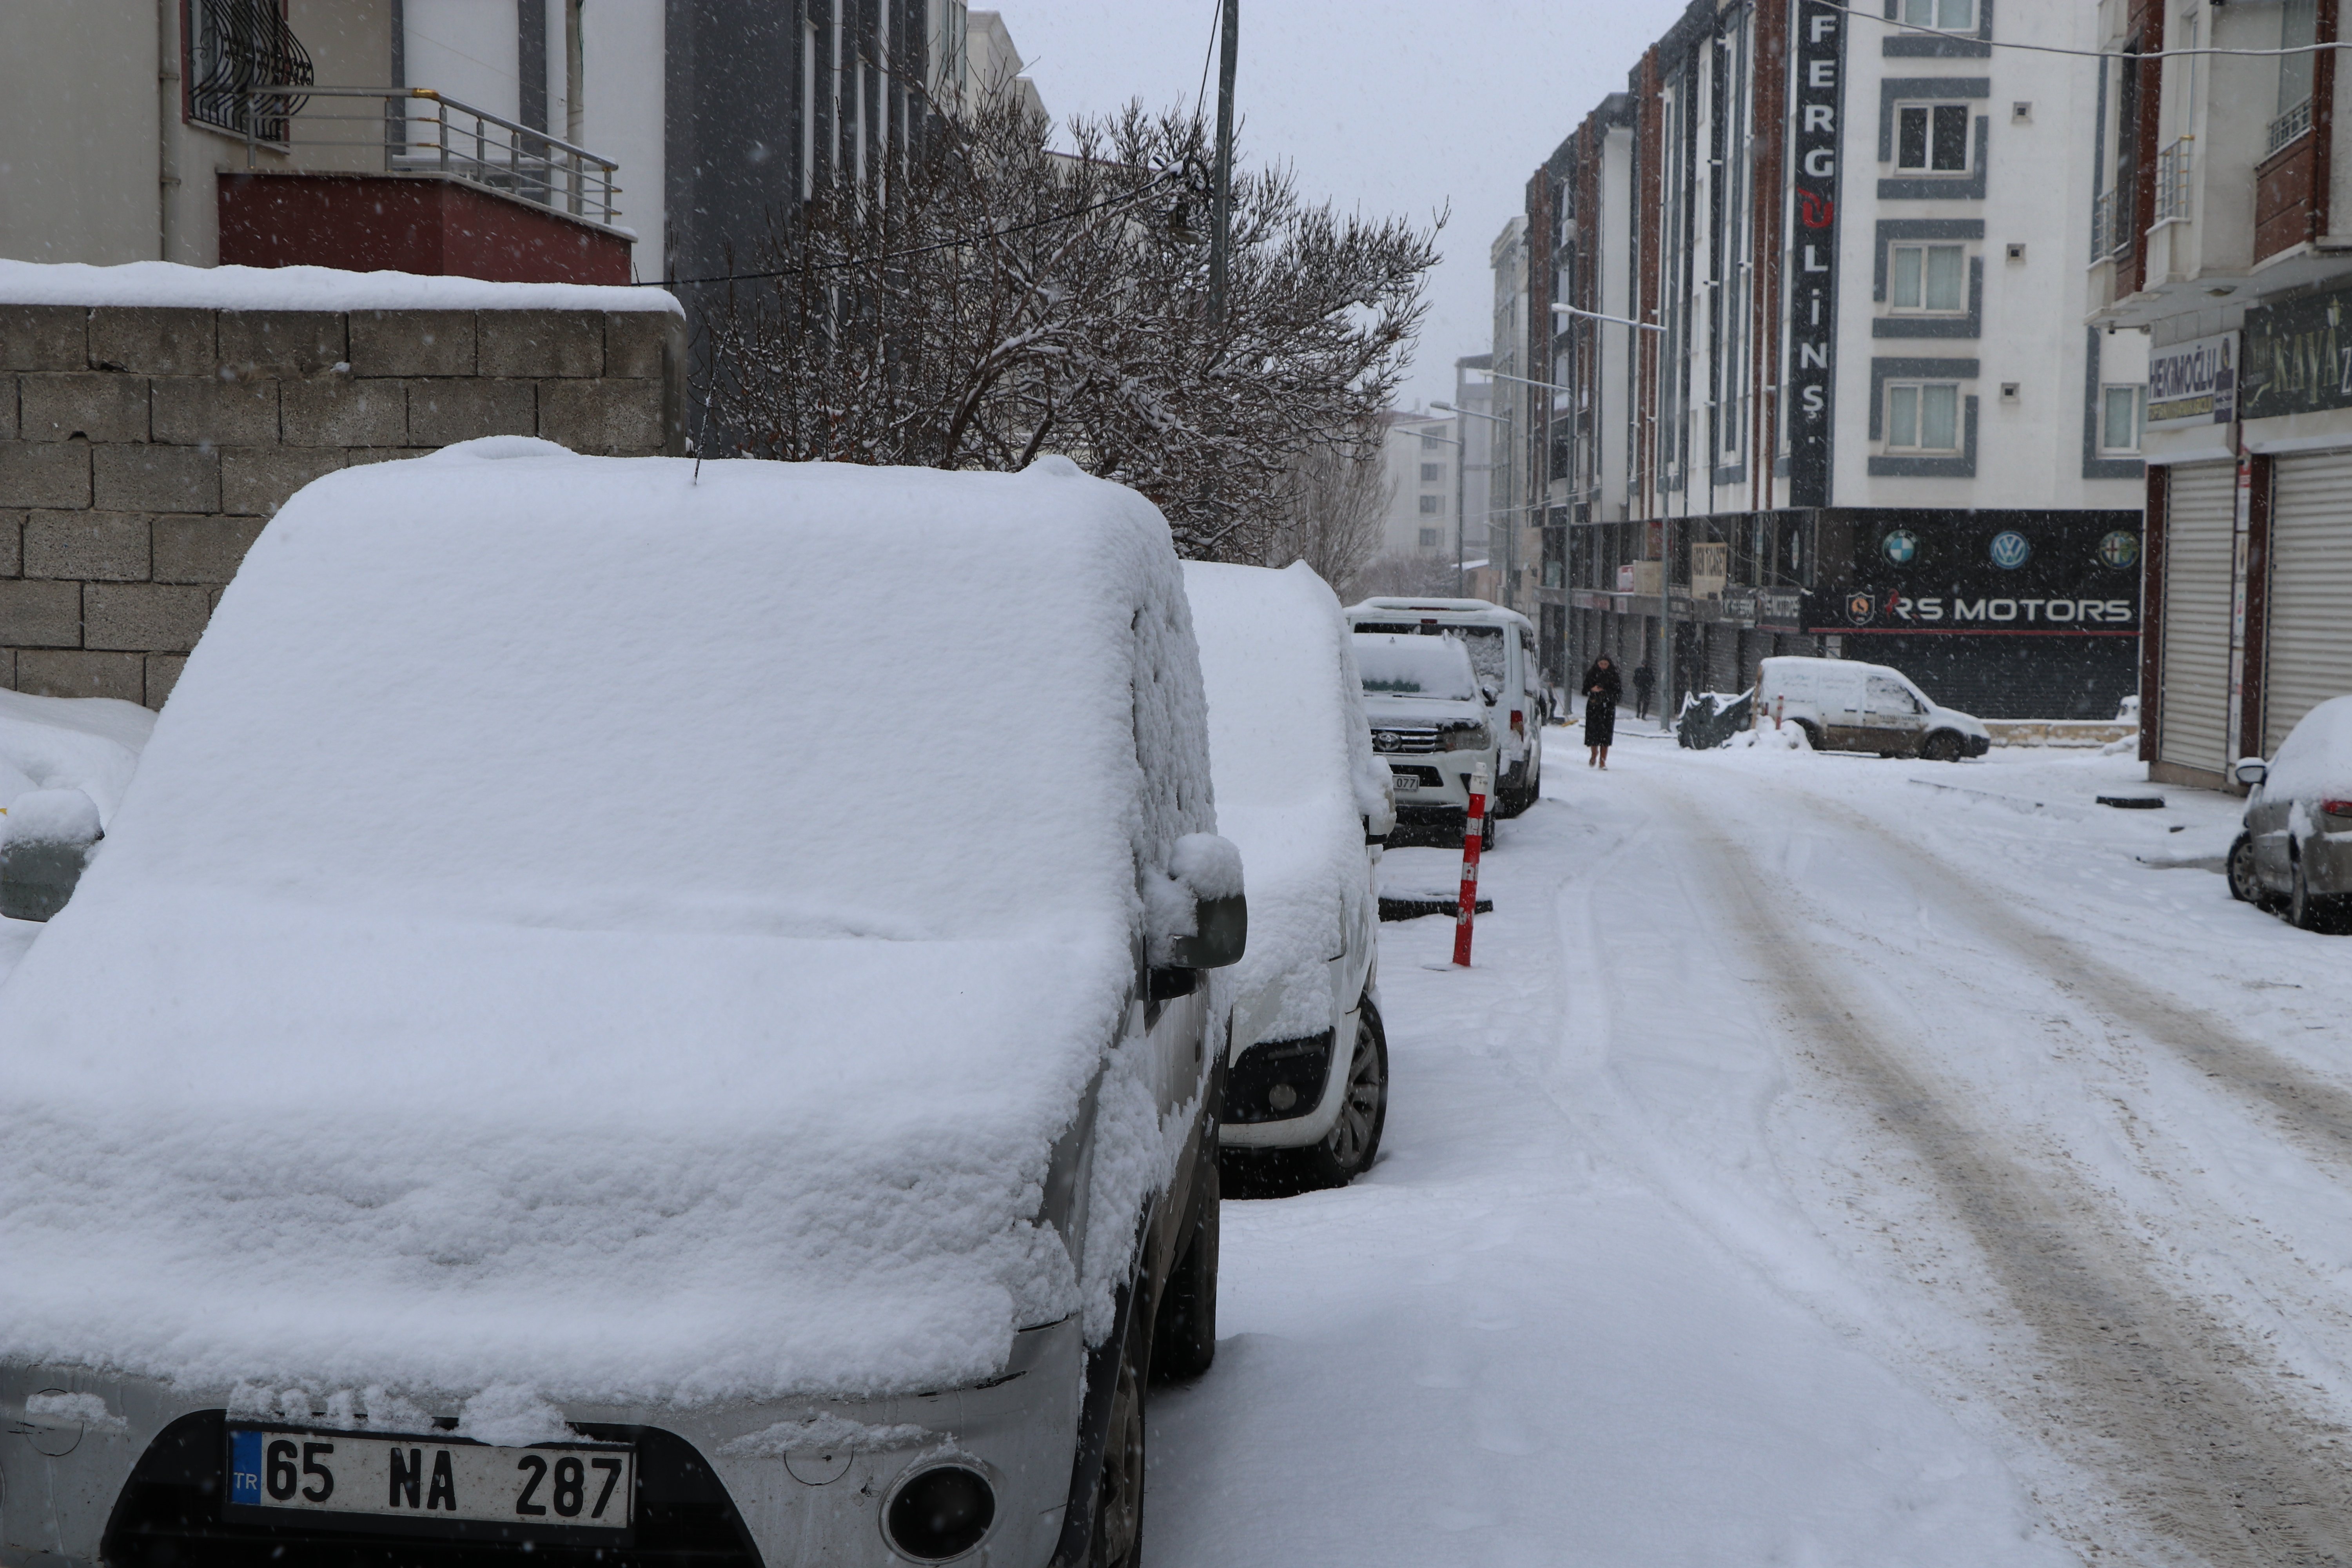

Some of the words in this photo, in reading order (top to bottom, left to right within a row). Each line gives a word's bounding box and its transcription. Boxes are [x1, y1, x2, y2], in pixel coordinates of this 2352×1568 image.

[2273, 328, 2339, 403] KAYA
[1955, 599, 2132, 622] MOTORS
[1397, 778, 1416, 788] 077
[234, 1472, 257, 1490] TR
[266, 1439, 334, 1502] 65
[389, 1447, 456, 1511] NA
[516, 1455, 622, 1519] 287
